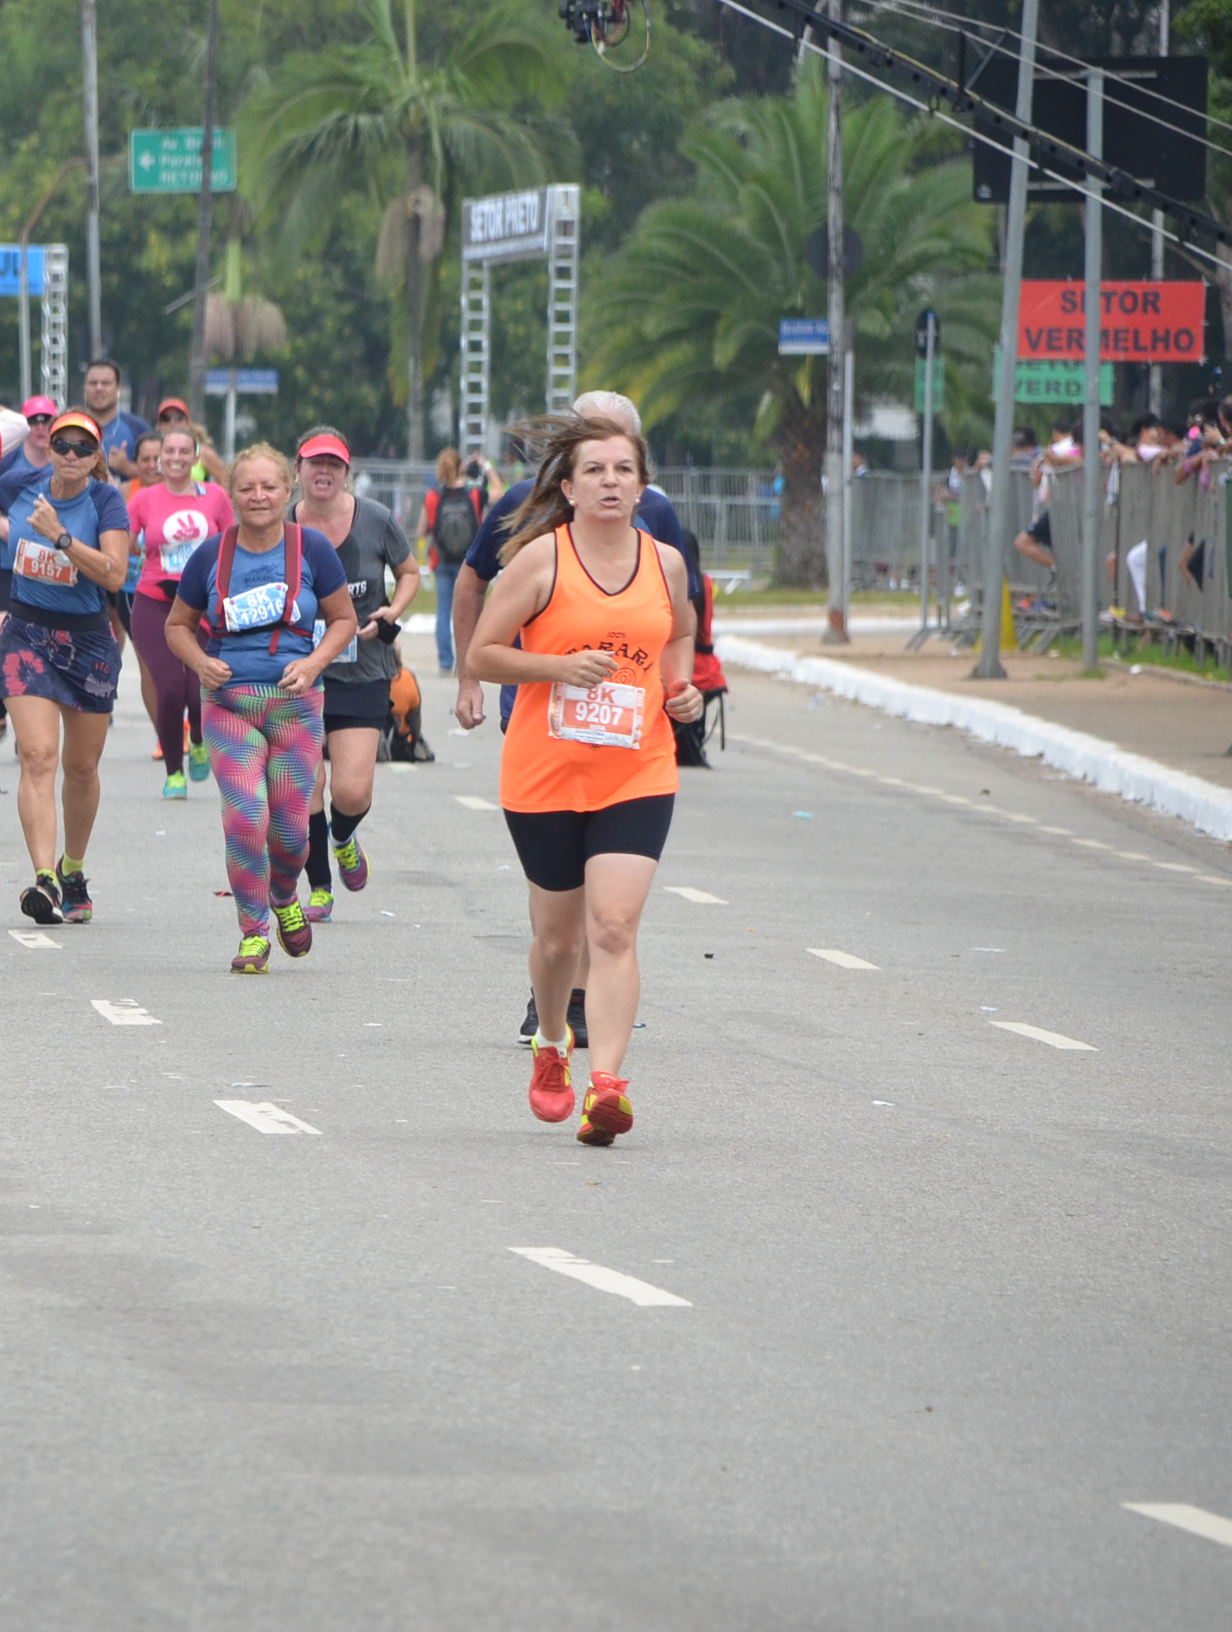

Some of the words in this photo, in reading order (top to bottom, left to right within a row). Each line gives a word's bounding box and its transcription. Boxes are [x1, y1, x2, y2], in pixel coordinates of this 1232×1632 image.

[470, 199, 503, 243] SETOR
[505, 191, 539, 238] PRETO
[1015, 380, 1082, 397] ERD
[38, 550, 57, 563] 8K
[31, 561, 63, 578] 9157
[247, 588, 270, 607] 8K
[240, 598, 284, 626] 12916
[586, 686, 617, 704] 8K
[574, 701, 624, 726] 9207
